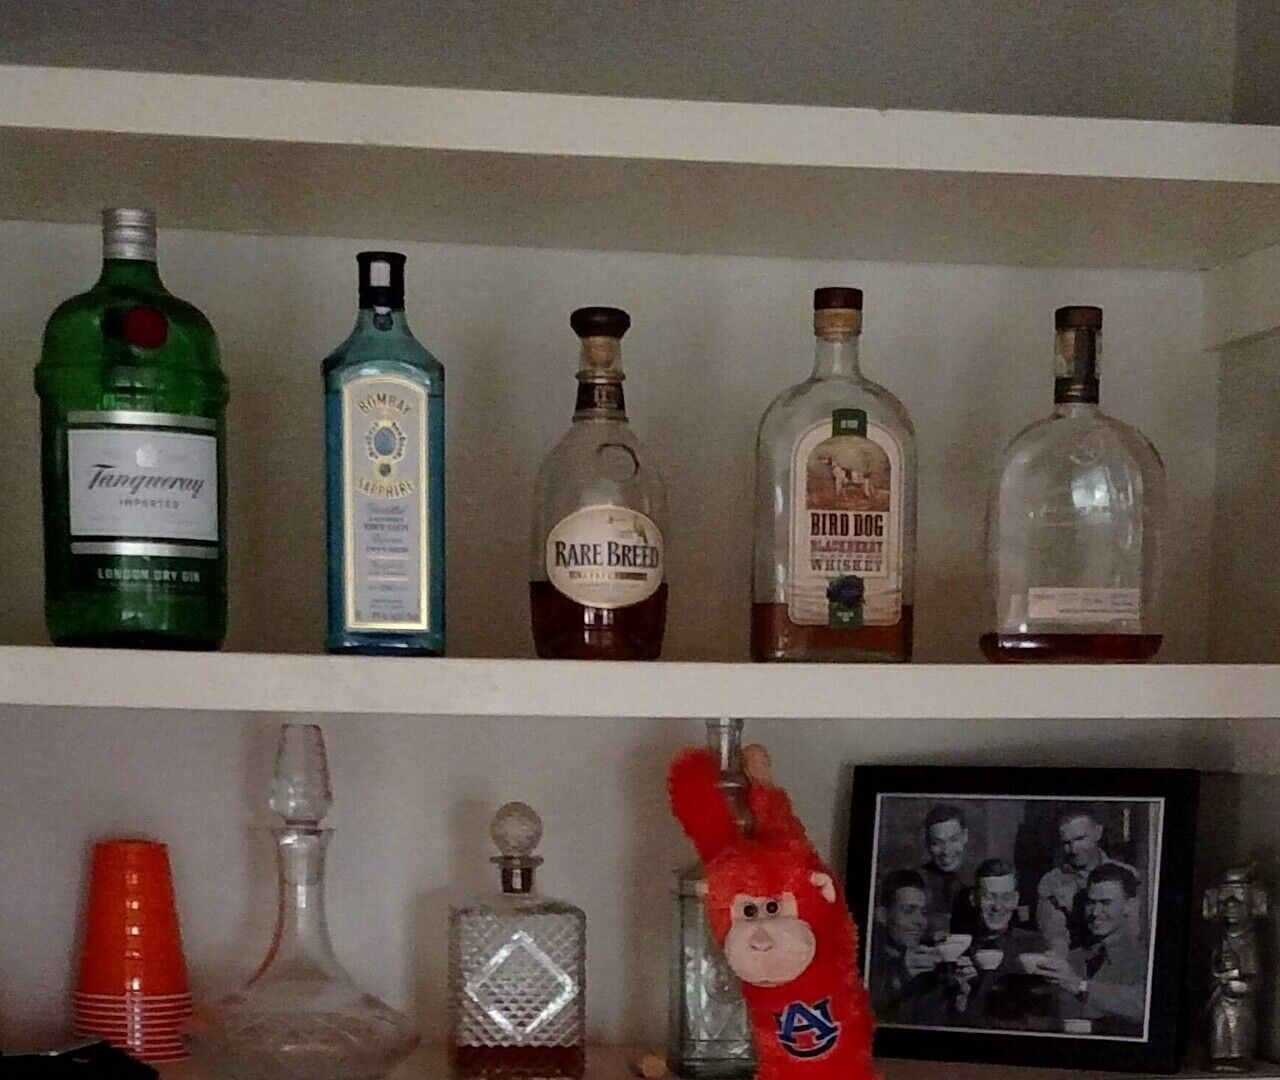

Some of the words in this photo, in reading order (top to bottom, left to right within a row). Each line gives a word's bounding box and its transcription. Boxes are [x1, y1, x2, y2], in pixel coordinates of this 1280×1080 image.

[357, 392, 412, 415] BOMBAY
[87, 463, 206, 500] Tanqueray
[357, 477, 414, 499] SAPPHIRE
[810, 512, 849, 537] BIRD
[853, 513, 884, 538] DOG
[554, 540, 605, 569] RARE
[607, 541, 660, 569] BREED
[809, 558, 884, 572] WHISKEY
[97, 568, 150, 581] LONDON
[153, 569, 179, 582] DRY
[181, 570, 201, 583] GIN
